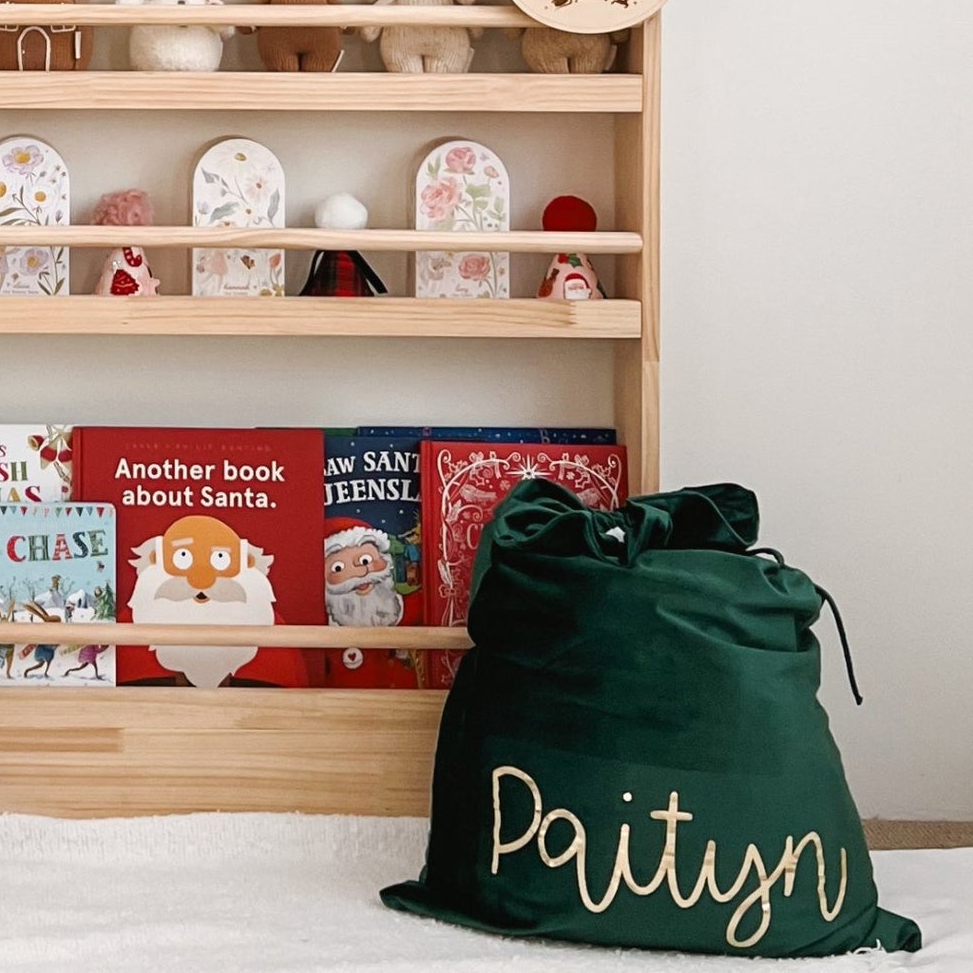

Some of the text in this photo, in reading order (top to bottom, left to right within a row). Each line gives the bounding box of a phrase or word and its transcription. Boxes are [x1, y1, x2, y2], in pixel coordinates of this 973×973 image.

[115, 458, 285, 483] Another book
[323, 456, 356, 476] AW
[122, 485, 277, 509] about Santa.
[6, 528, 109, 563] CHASE
[492, 765, 848, 948] Paityn
